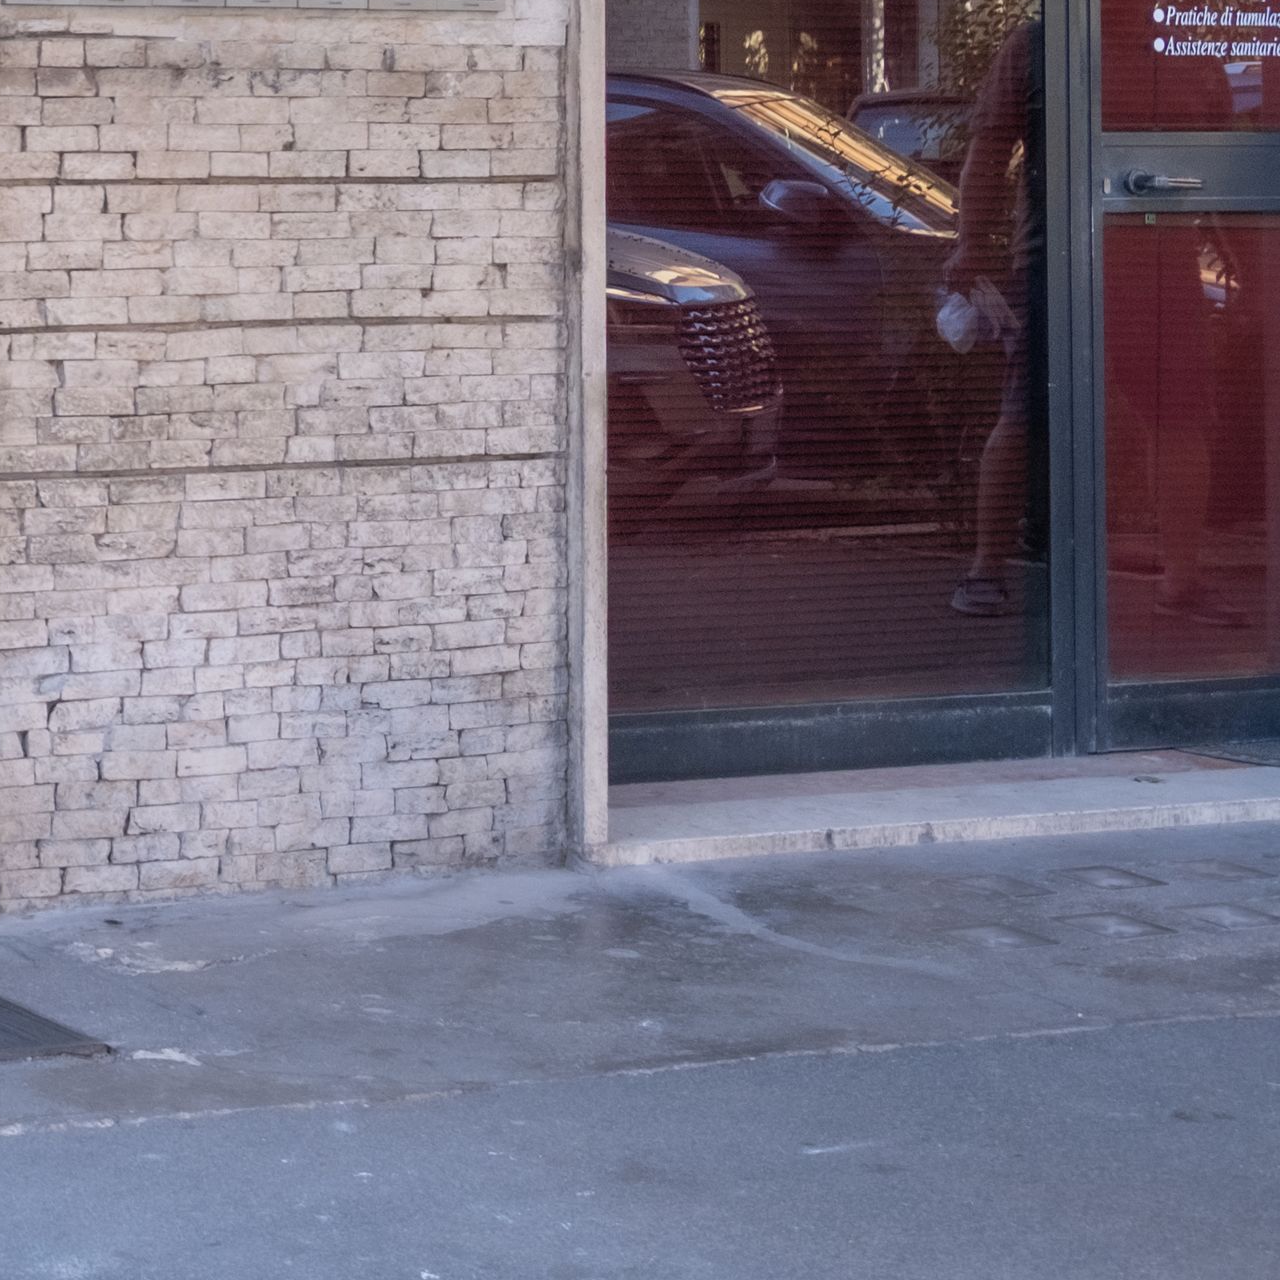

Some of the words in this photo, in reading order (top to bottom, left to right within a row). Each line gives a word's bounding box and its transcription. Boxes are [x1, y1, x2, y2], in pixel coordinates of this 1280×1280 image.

[1165, 5, 1218, 26] Pratiche
[1220, 6, 1233, 26] di
[1165, 35, 1228, 58] Assistenze
